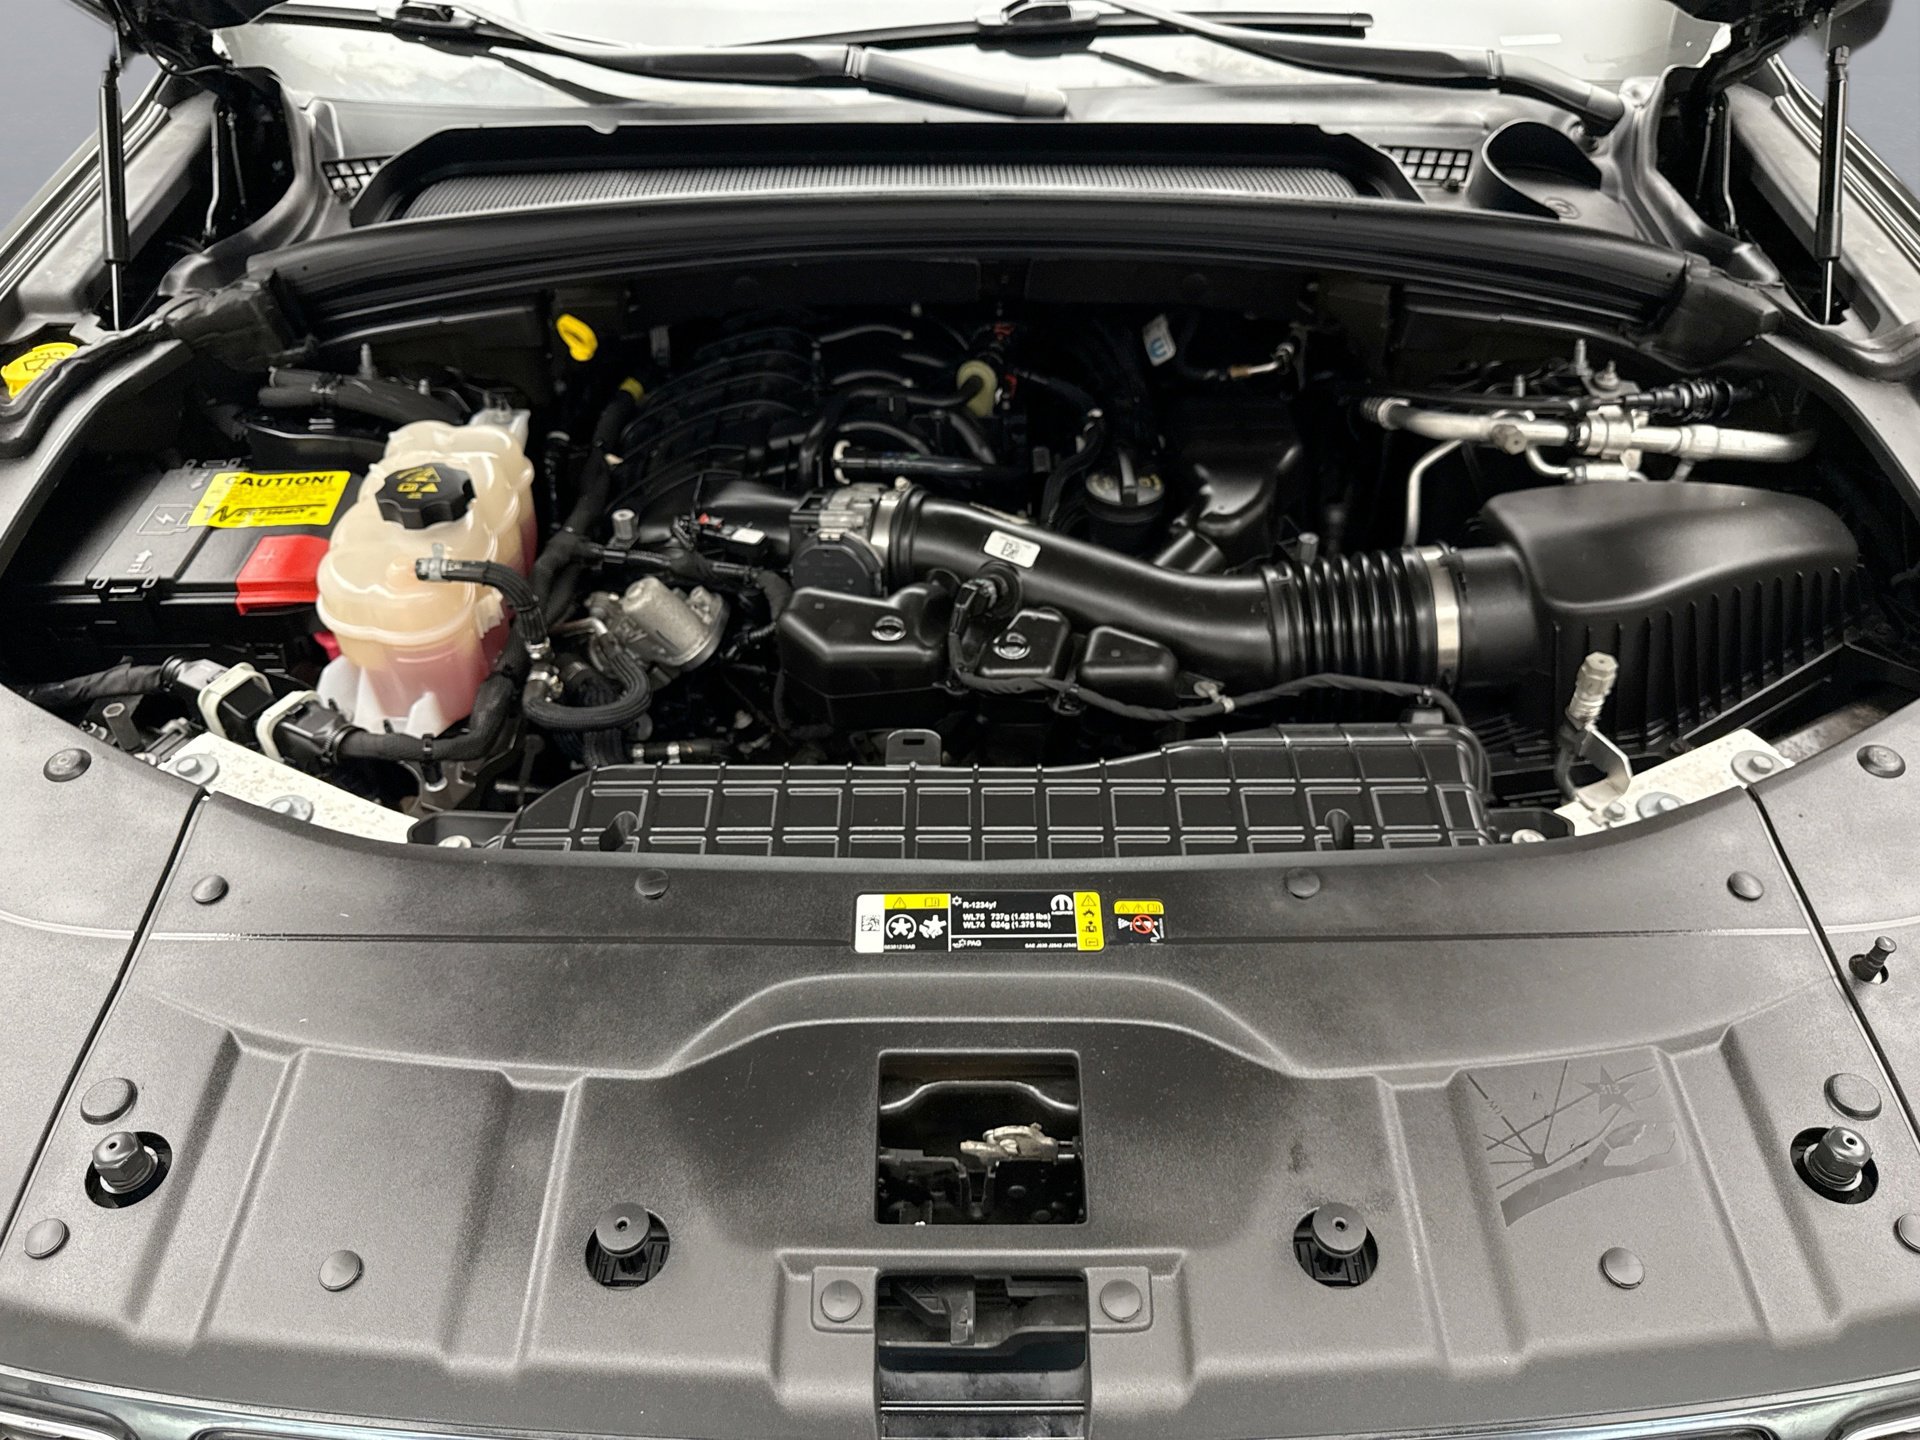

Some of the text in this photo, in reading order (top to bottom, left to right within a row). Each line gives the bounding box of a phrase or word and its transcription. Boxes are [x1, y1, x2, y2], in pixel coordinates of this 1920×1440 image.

[225, 475, 335, 487] CAUTION!
[962, 901, 997, 910] R-1234yf
[962, 913, 985, 921] WL75
[991, 913, 1010, 921] 737g
[1036, 912, 1051, 921] lbs)
[1036, 921, 1051, 929] lbs)
